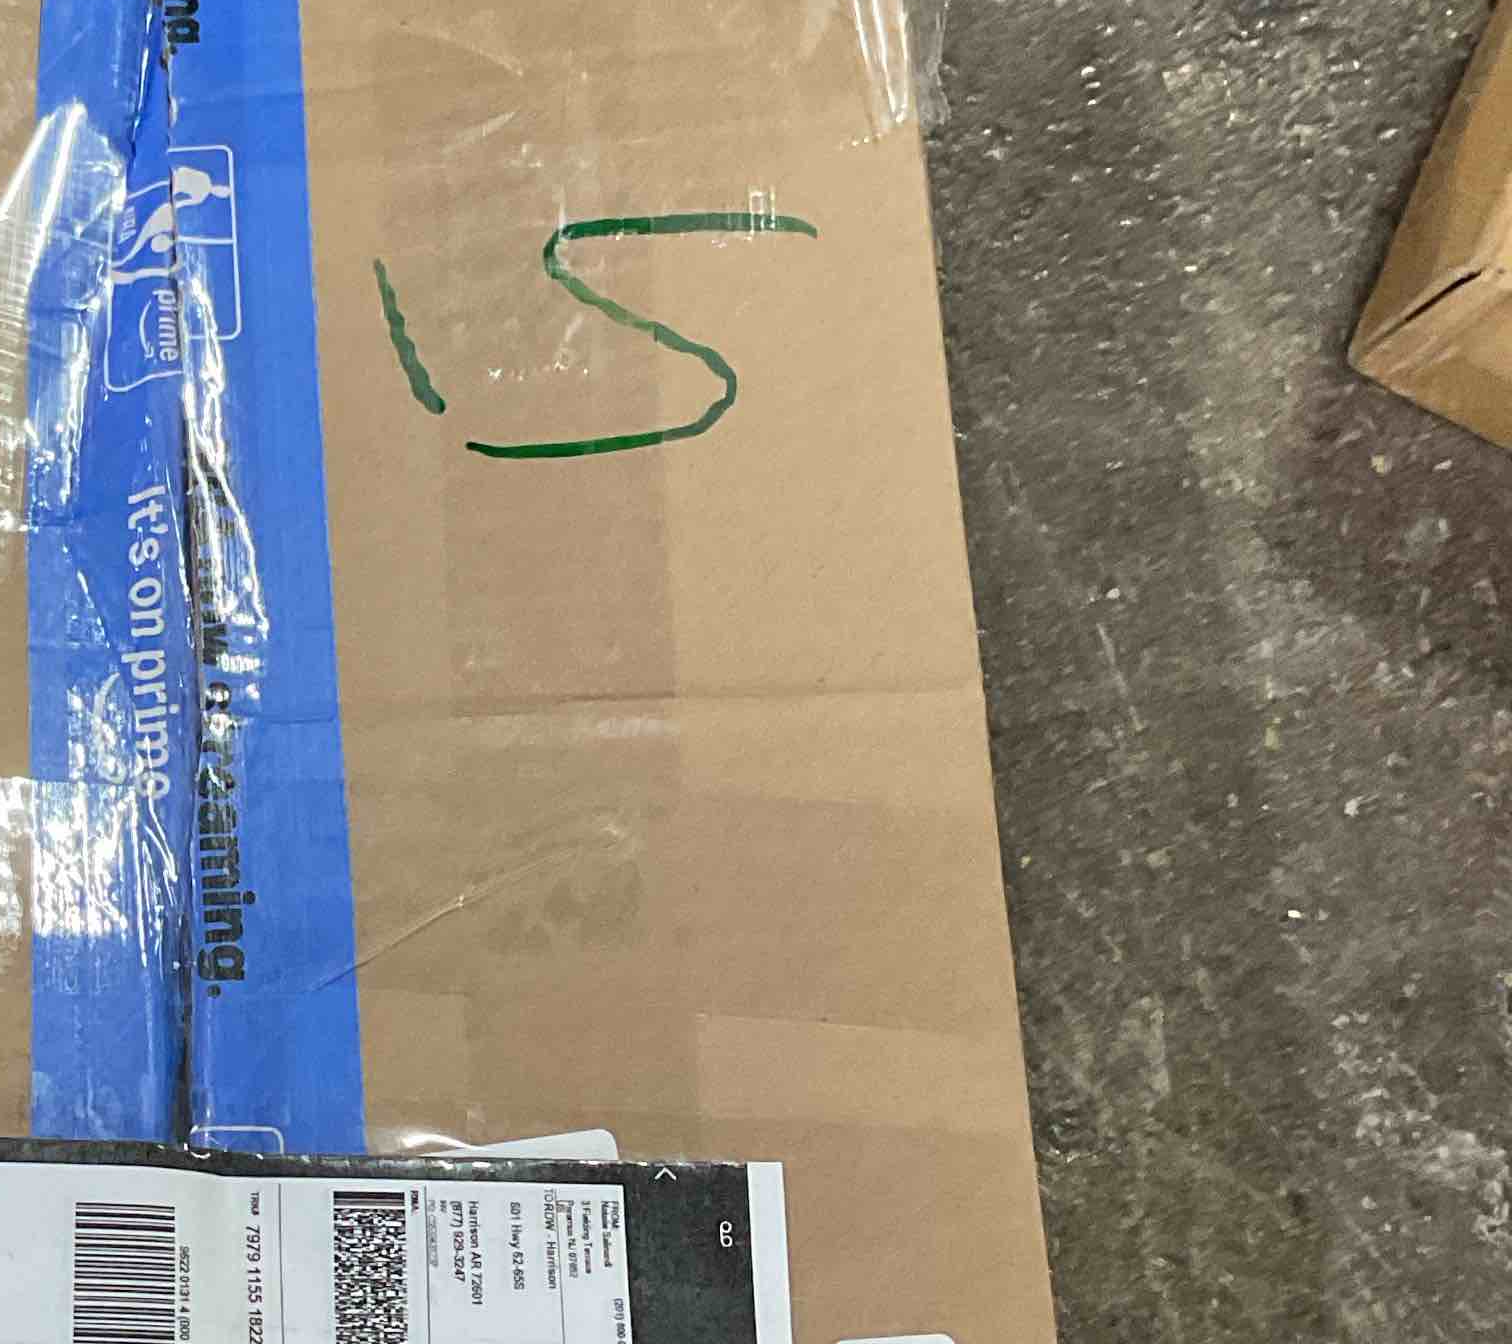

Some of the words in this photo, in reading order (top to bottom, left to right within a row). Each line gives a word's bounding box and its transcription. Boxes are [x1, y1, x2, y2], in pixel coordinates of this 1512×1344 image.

[127, 485, 169, 572] It's
[126, 577, 167, 637] on
[119, 649, 180, 800] prime
[245, 1225, 262, 1262] 7979
[468, 1201, 482, 1249] Harrison
[470, 1251, 484, 1270] AR
[546, 1241, 557, 1289] Harrison
[178, 1276, 191, 1303] 0131
[247, 1267, 263, 1303] 1155
[471, 1272, 484, 1306] 72601
